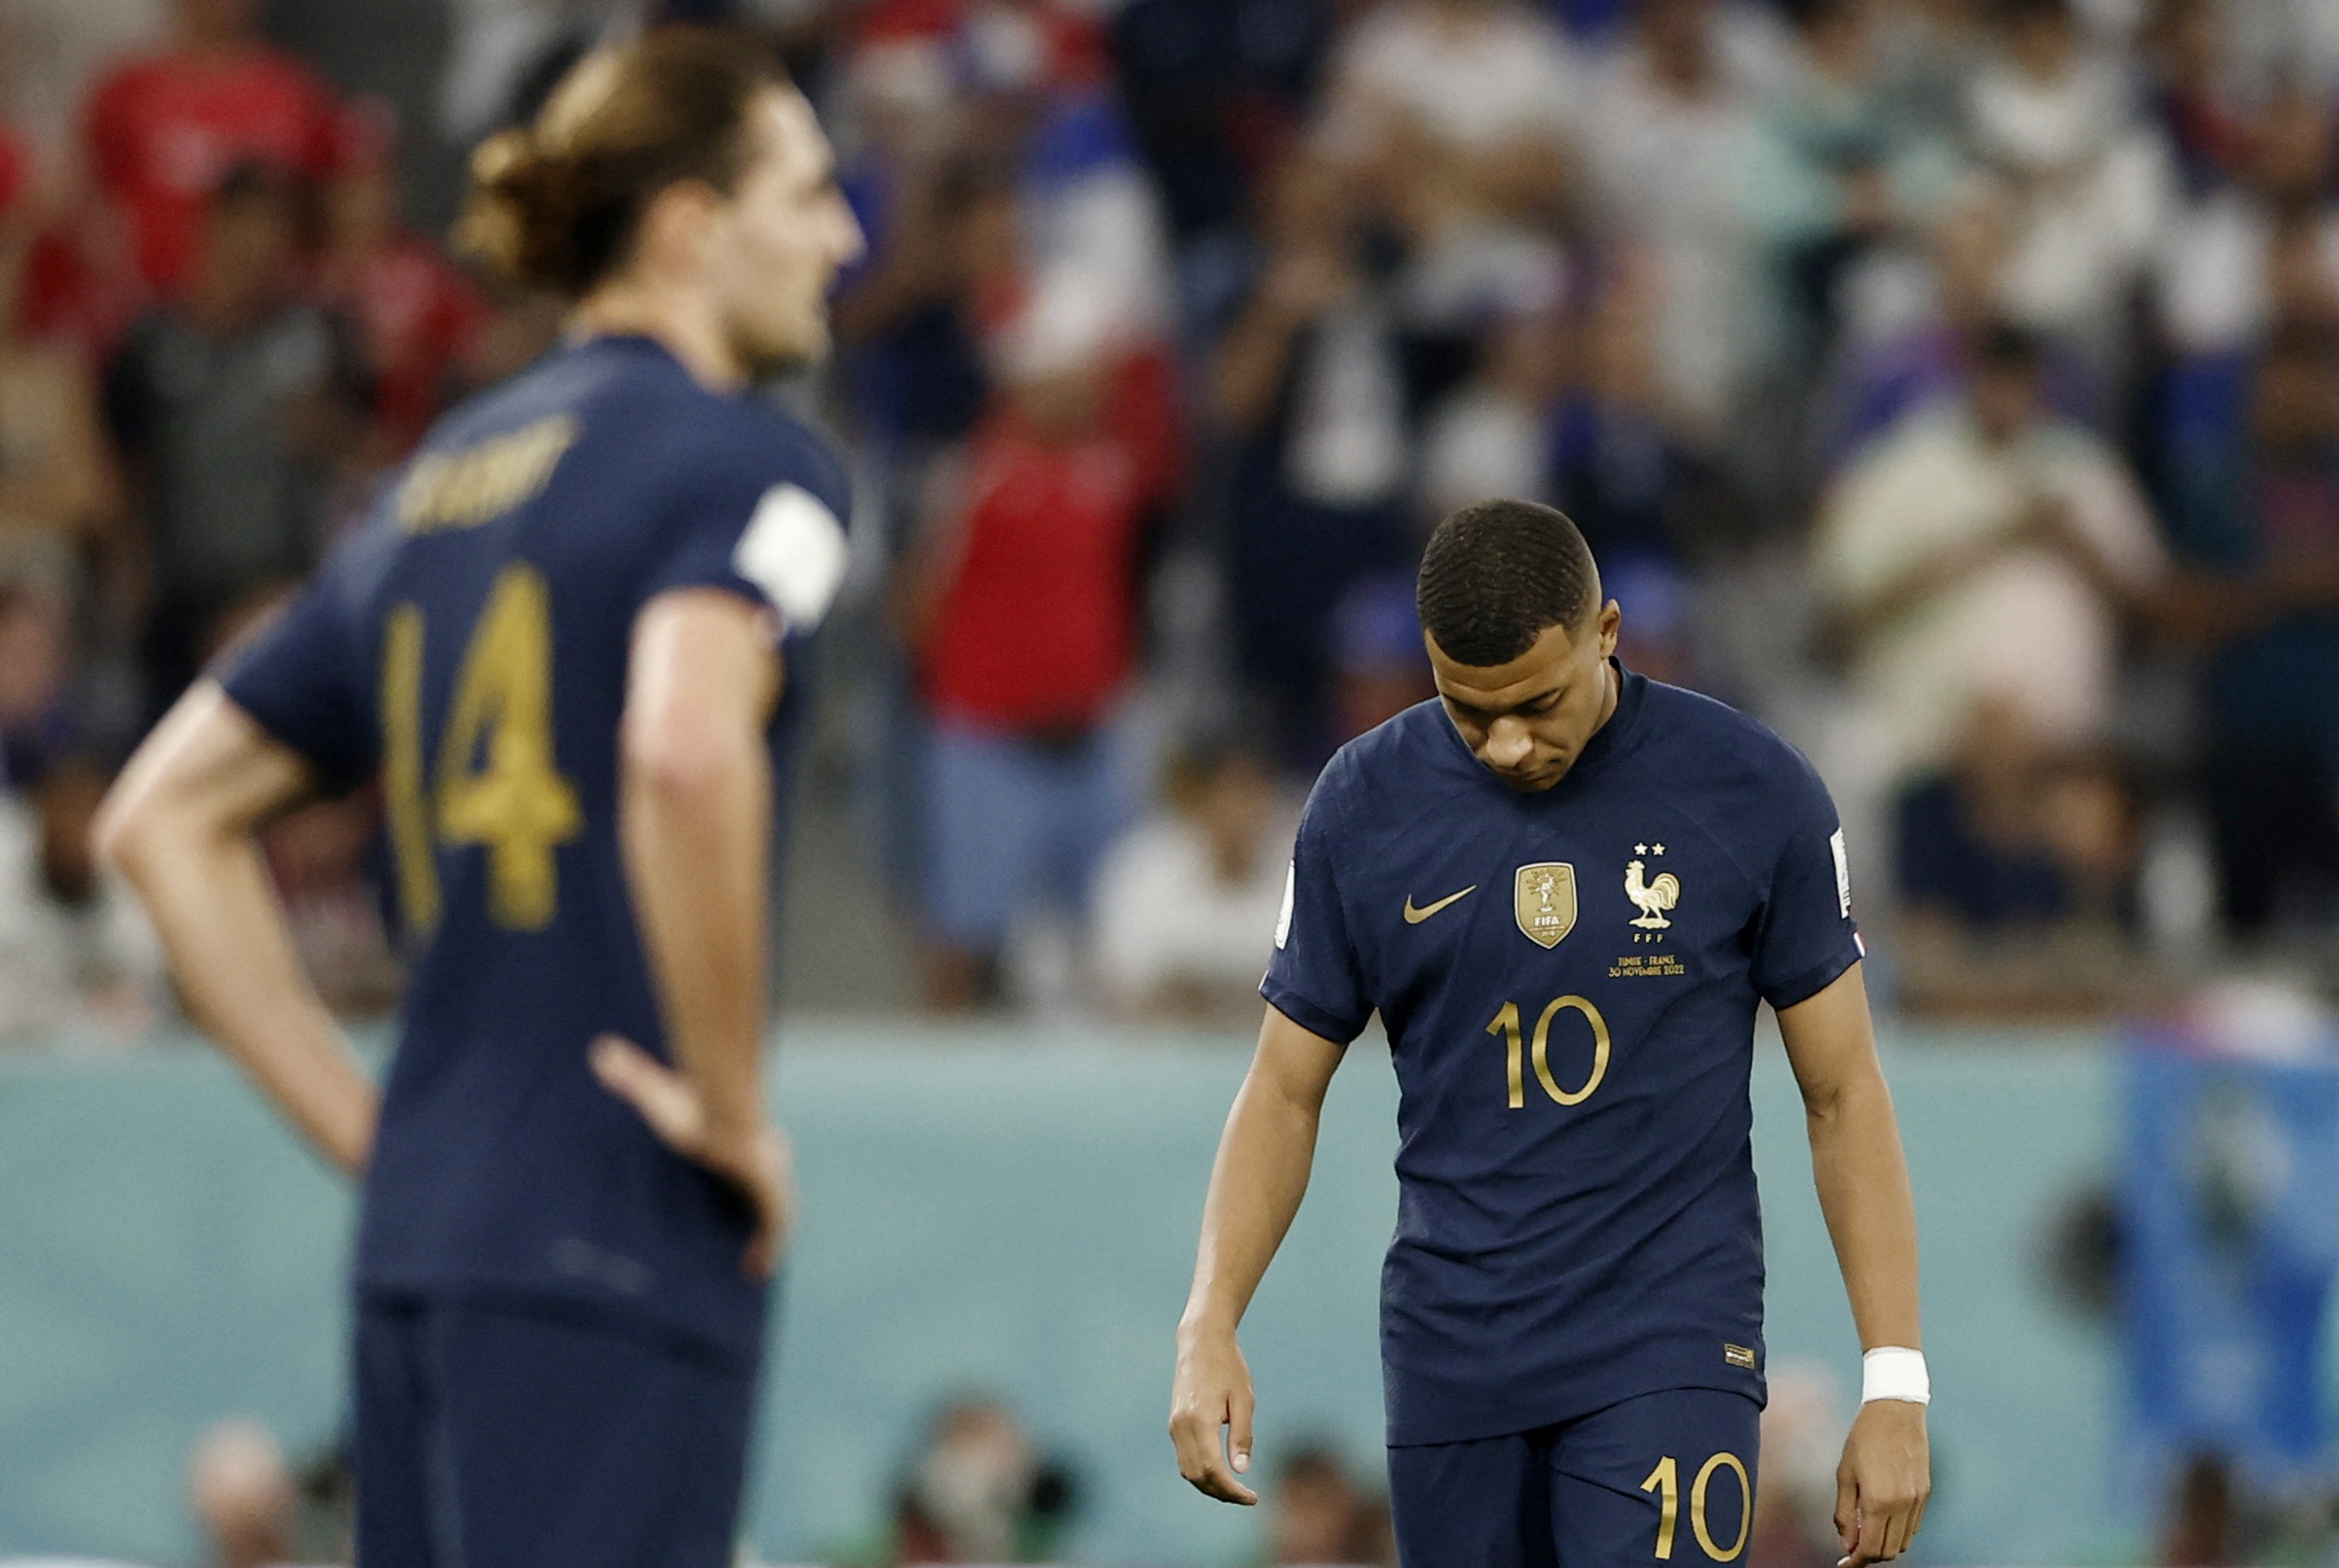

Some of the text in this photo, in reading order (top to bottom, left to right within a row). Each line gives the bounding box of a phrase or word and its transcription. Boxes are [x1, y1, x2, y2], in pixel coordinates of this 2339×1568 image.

[382, 561, 583, 934] 14
[1534, 916, 1560, 926] FIFA
[1608, 967, 1622, 978] 30
[1663, 964, 1685, 975] 2022
[1485, 994, 1611, 1109] 10
[1640, 1452, 1751, 1563] 10
